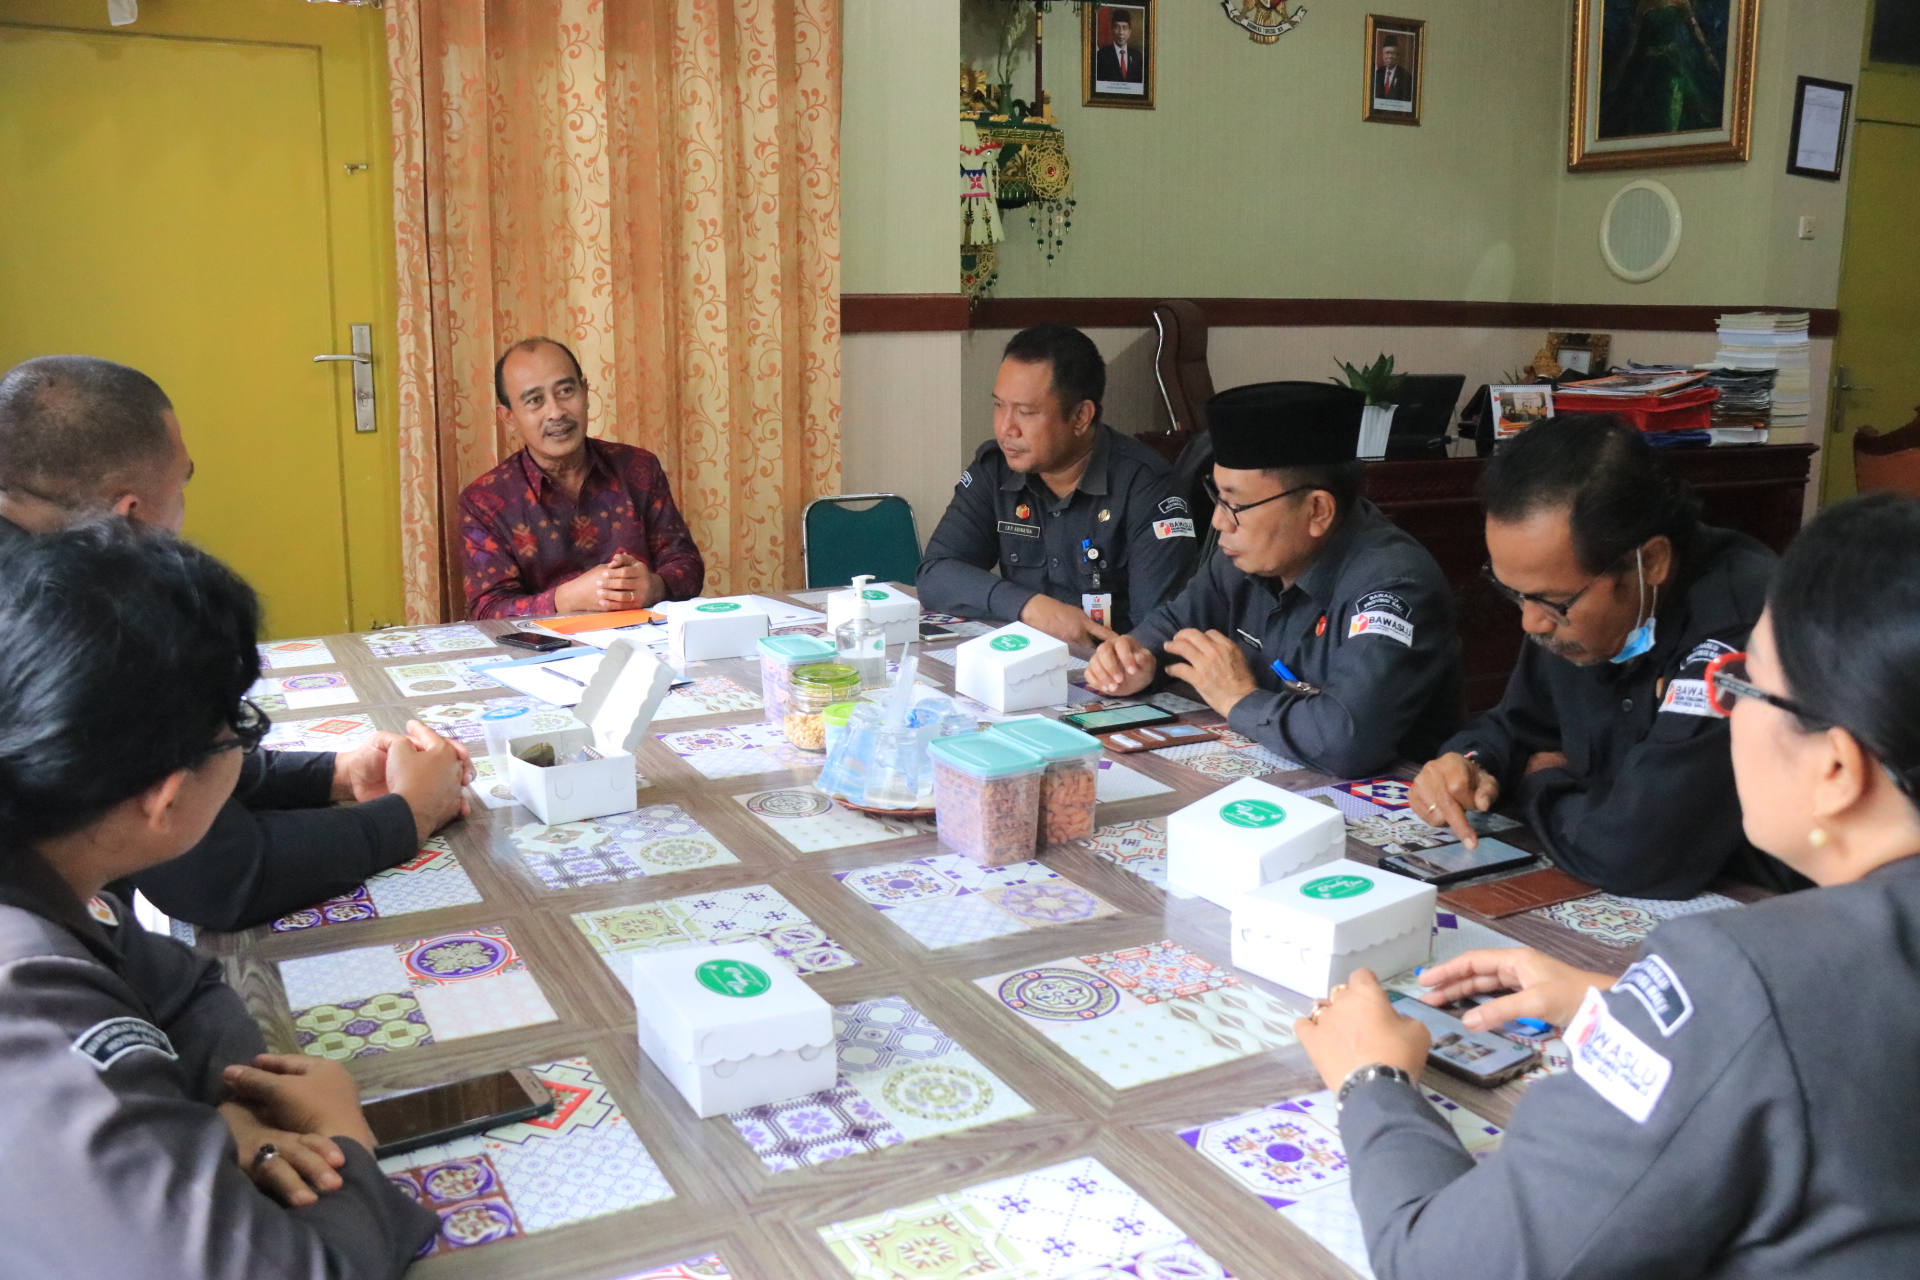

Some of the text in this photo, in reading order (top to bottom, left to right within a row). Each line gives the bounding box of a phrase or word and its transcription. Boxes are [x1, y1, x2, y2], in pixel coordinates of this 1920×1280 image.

[1364, 598, 1403, 612] PROVINSI BALI
[1369, 593, 1399, 603] BAWASLU
[1369, 615, 1412, 637] BAWASLU
